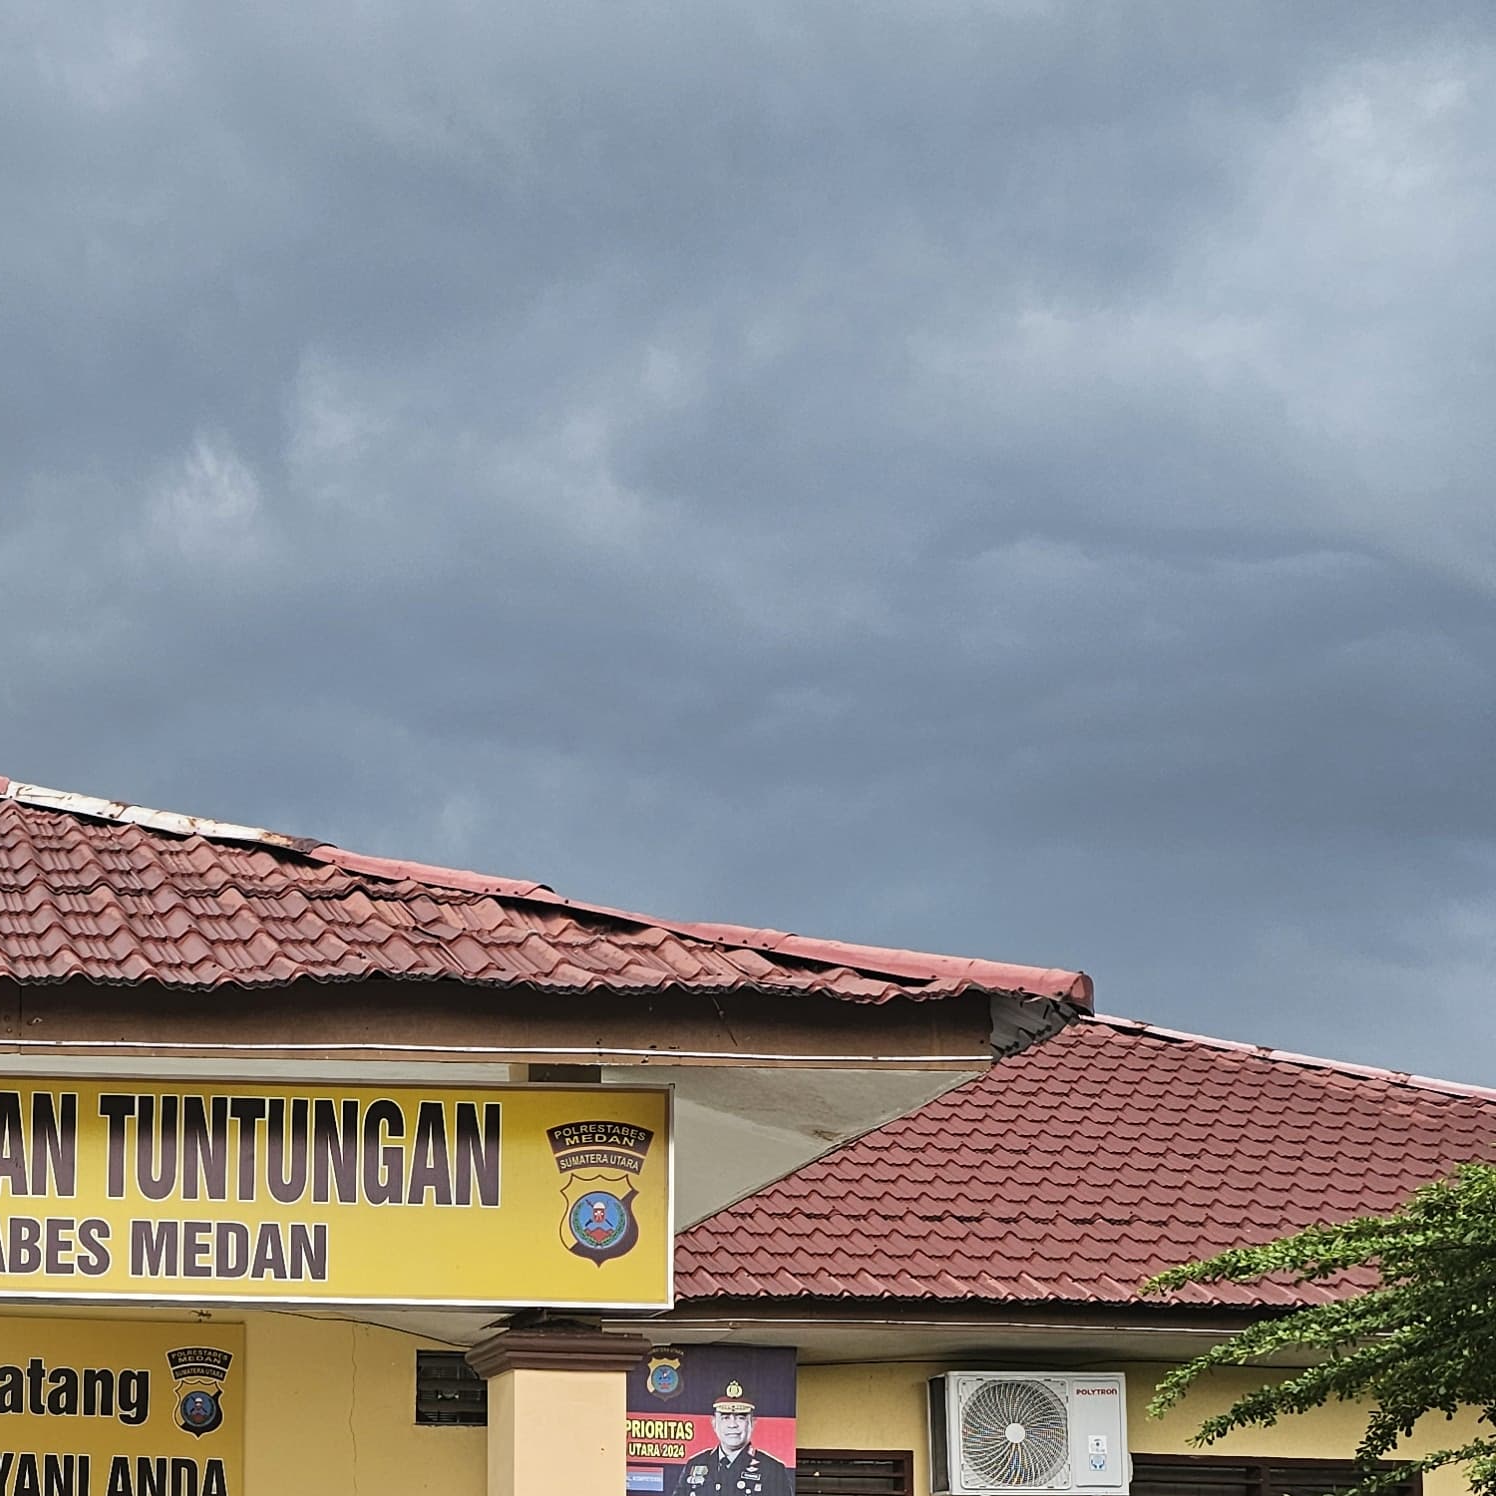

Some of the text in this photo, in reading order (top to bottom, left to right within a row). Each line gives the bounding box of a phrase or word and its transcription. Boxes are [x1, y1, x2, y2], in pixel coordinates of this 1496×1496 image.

[554, 1124, 646, 1141] POLRESTABES
[565, 1134, 635, 1147] MEDAN
[99, 1093, 501, 1207] TUNTUNGAN
[559, 1153, 639, 1170] SUMATERA UTARA
[130, 1218, 328, 1281] MEDAN
[626, 1419, 694, 1440] PRIORITAS
[629, 1443, 685, 1458] UTARA 2024
